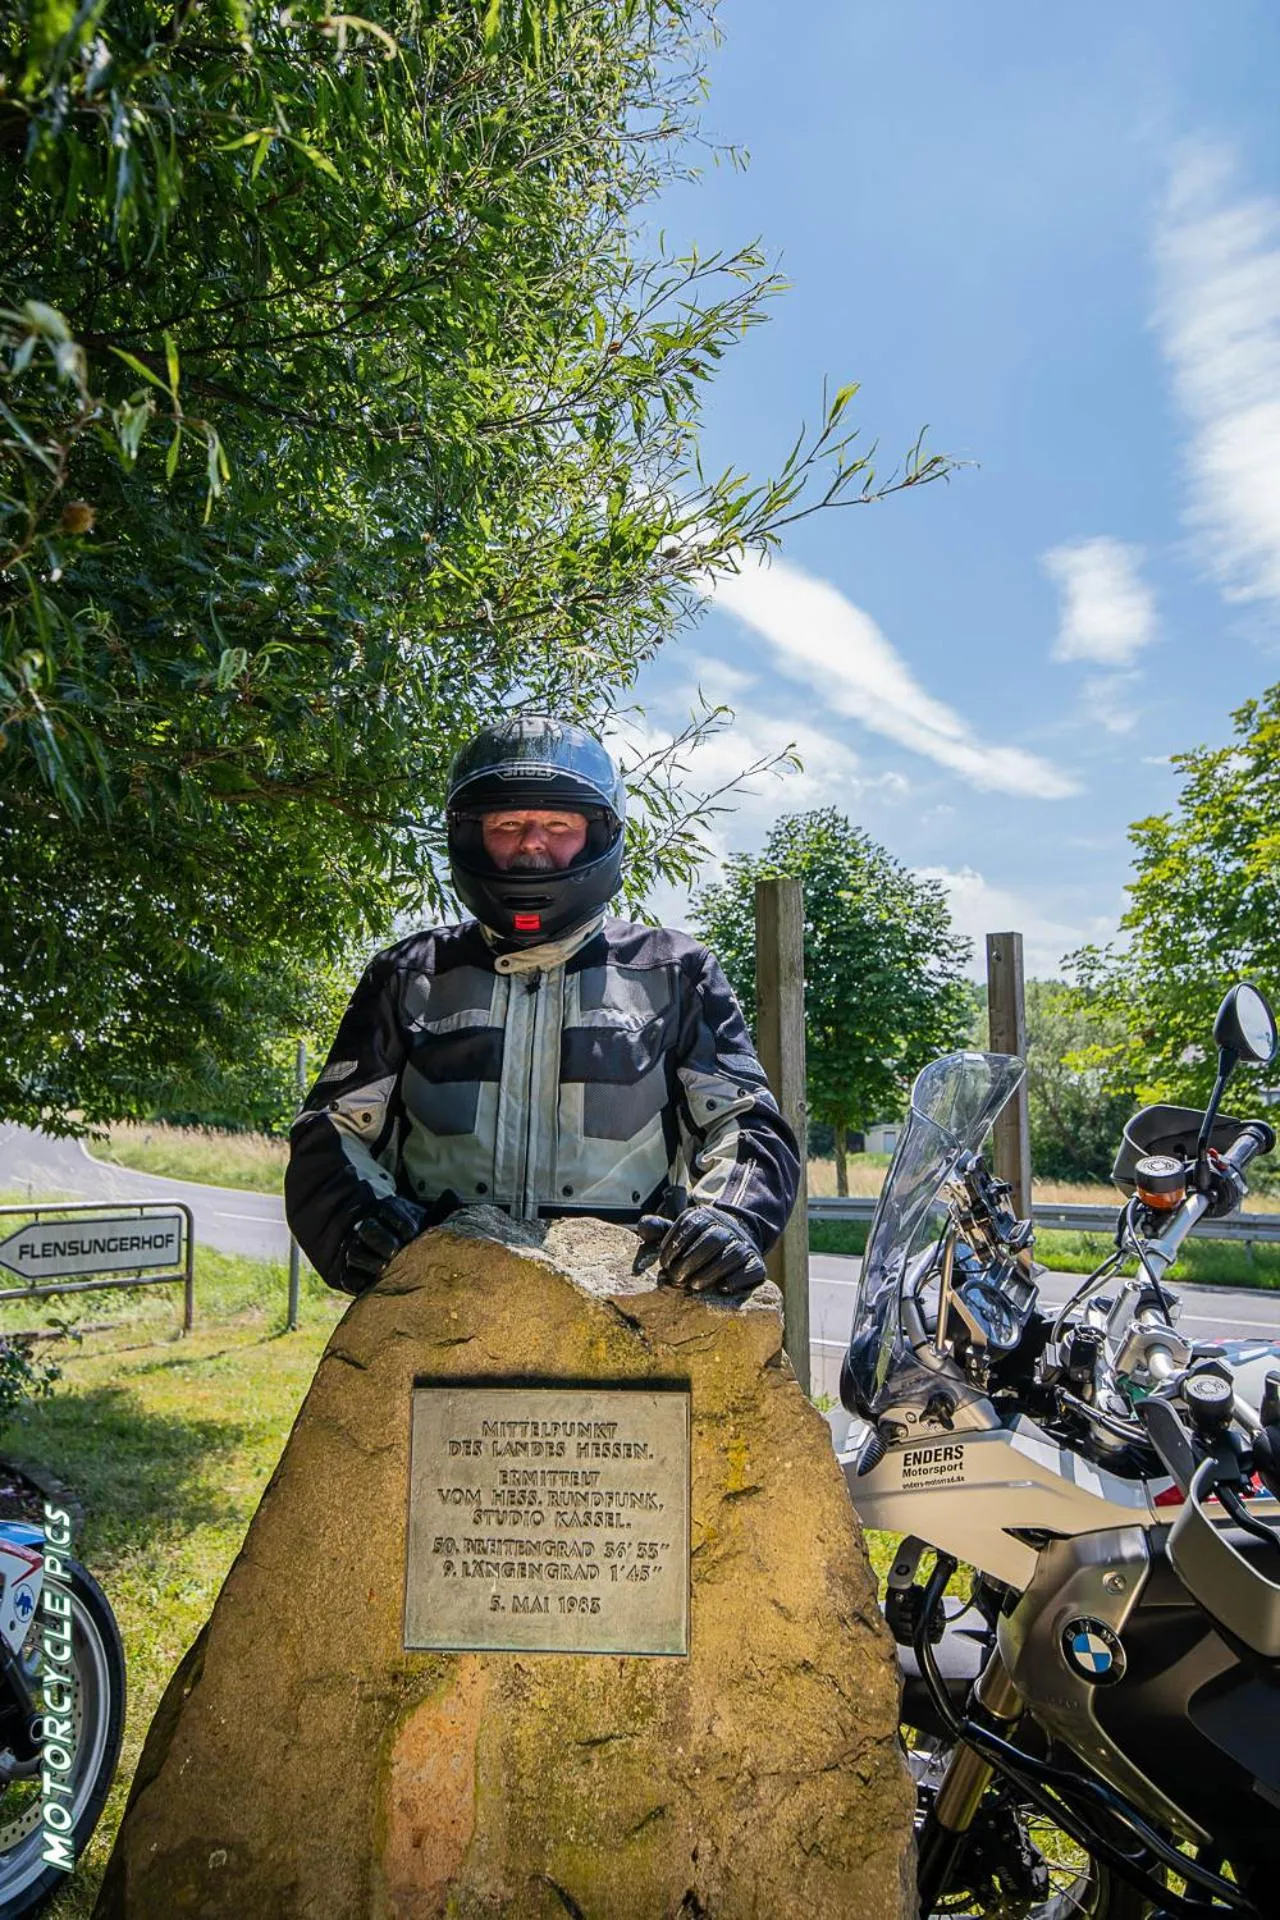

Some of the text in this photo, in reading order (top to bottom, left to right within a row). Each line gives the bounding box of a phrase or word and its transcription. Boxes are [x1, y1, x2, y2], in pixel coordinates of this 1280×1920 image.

[18, 1233, 175, 1260] FLENSUNGERHOF
[481, 1420, 618, 1439] MITTELPUNKT
[448, 1439, 654, 1460] DES LANDES HESSEN.
[903, 1445, 964, 1467] ENDERS
[499, 1470, 601, 1487] ERMITTELT
[902, 1461, 964, 1478] Motorsport
[437, 1488, 665, 1512] VOM HESS. RUNDFUNK,
[472, 1509, 632, 1528] STUDIO KASSEL.
[463, 1537, 595, 1558] BREITENGRAD
[511, 1594, 550, 1614] MAI
